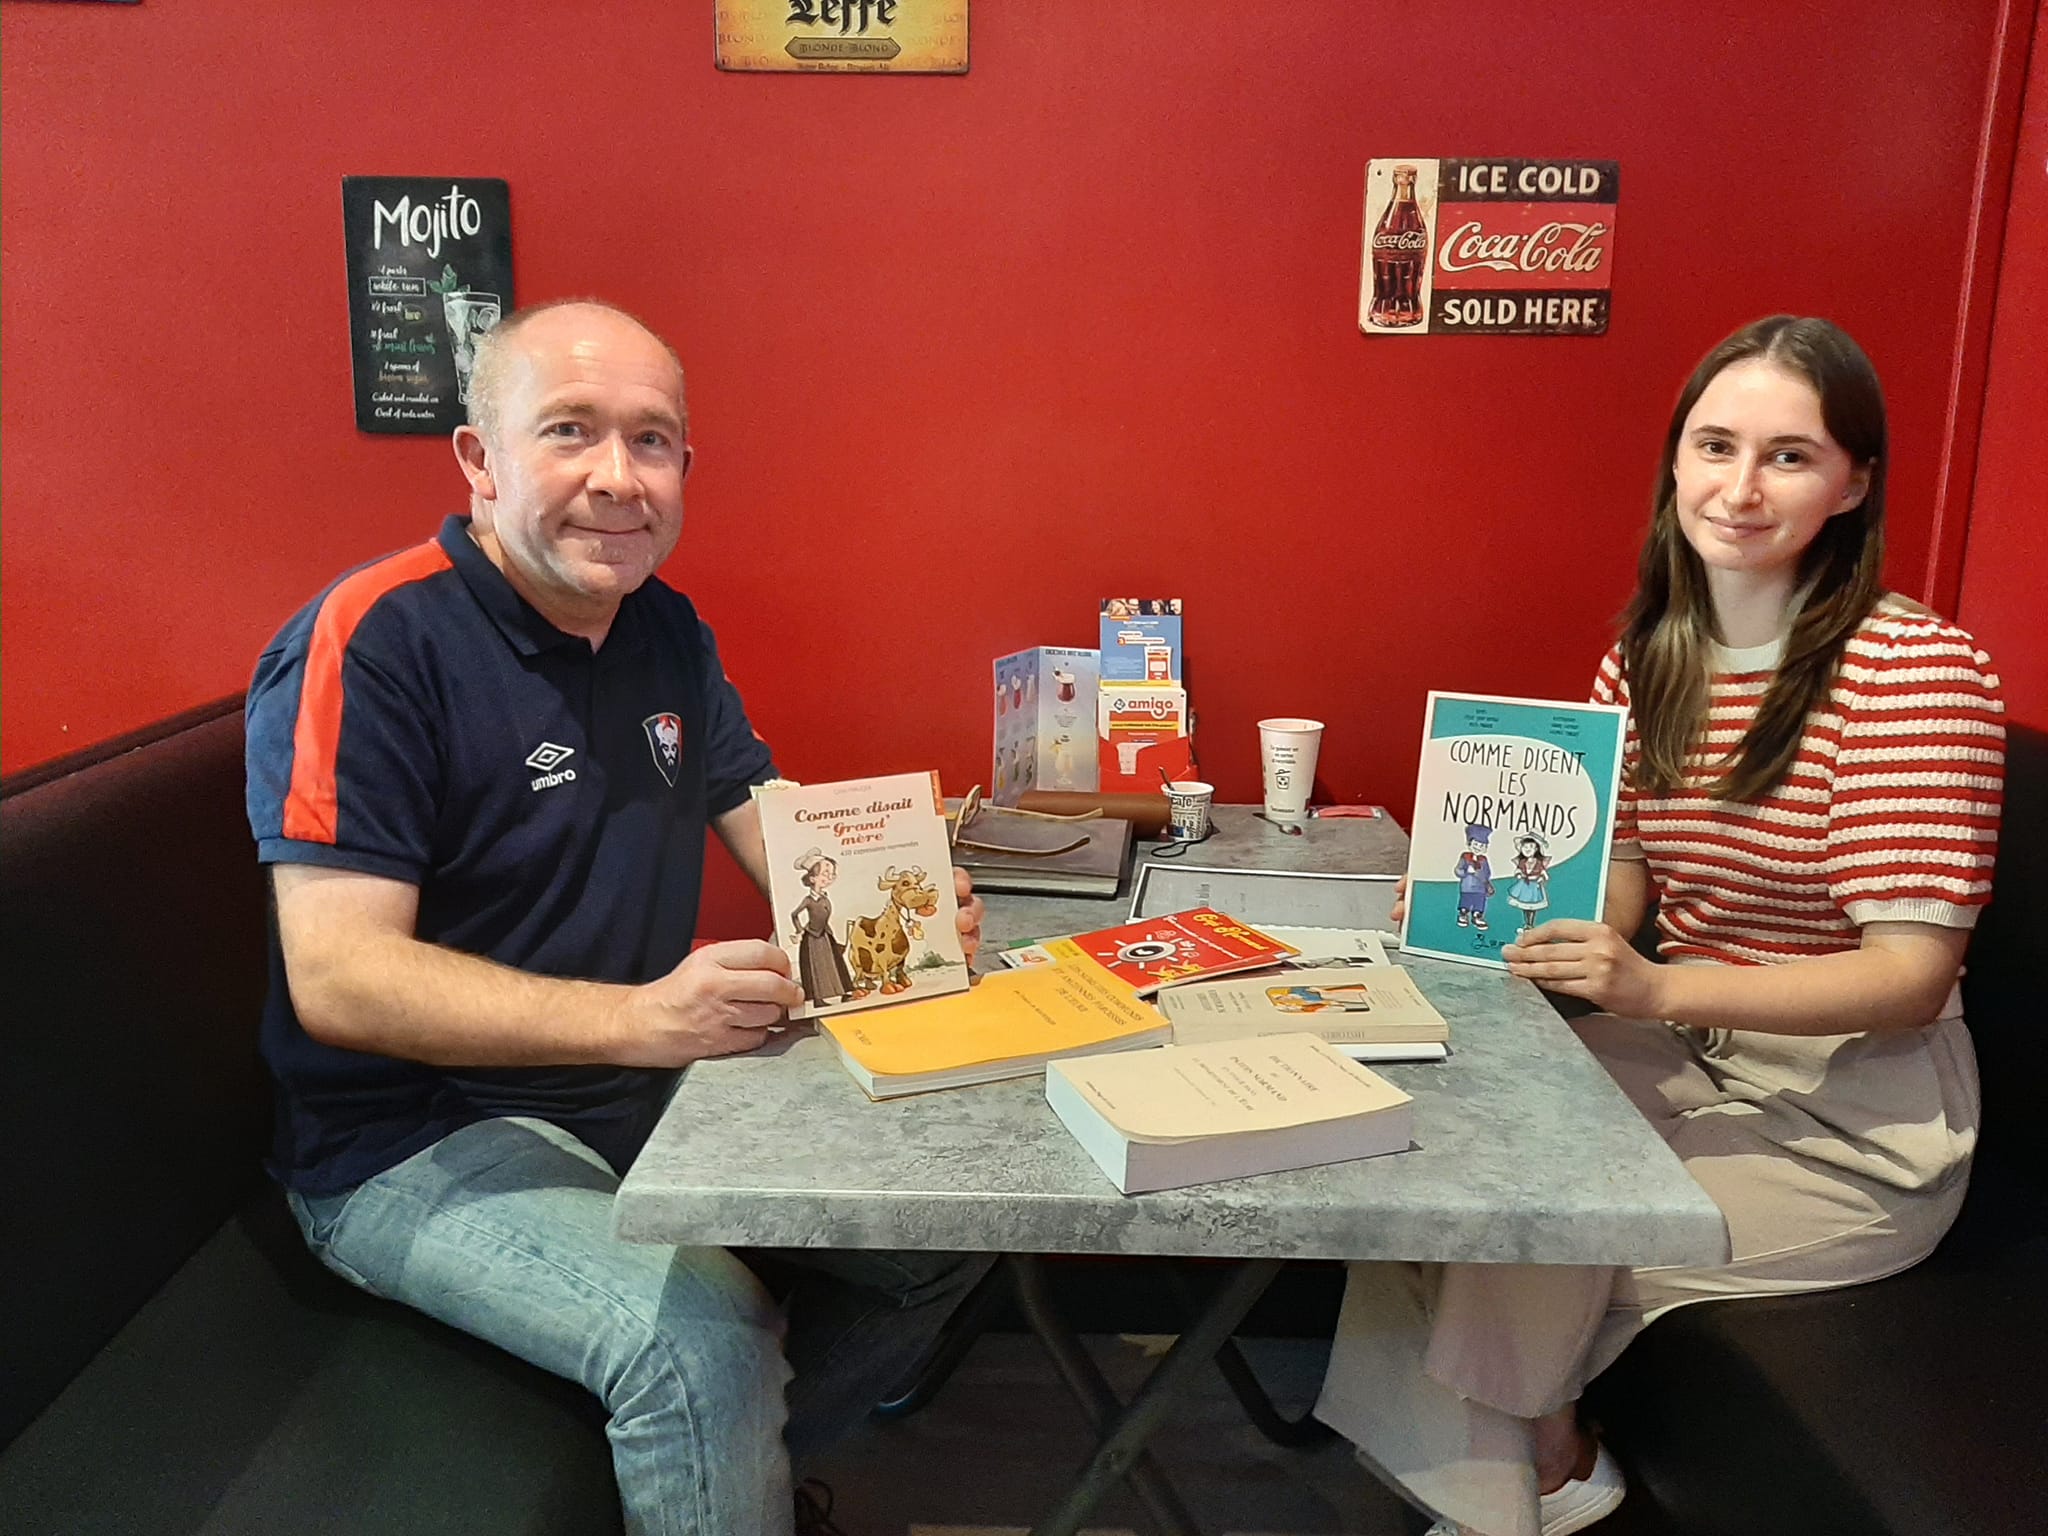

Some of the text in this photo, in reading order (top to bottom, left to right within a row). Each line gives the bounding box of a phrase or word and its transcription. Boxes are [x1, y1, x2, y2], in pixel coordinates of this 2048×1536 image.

[1459, 165, 1600, 194] ICE COLD
[373, 184, 481, 259] Mojito
[1373, 229, 1427, 250] Coca-Cola
[1438, 221, 1608, 273] Coca-Cola
[1443, 299, 1598, 327] SOLD HERE
[1128, 696, 1174, 717] amigo
[1450, 740, 1586, 776] COMME DISENT
[531, 769, 577, 791] umbro
[1499, 771, 1527, 797] LES
[794, 798, 913, 823] Comme disait
[1442, 791, 1578, 839] NORMANDS
[840, 833, 884, 846] mère
